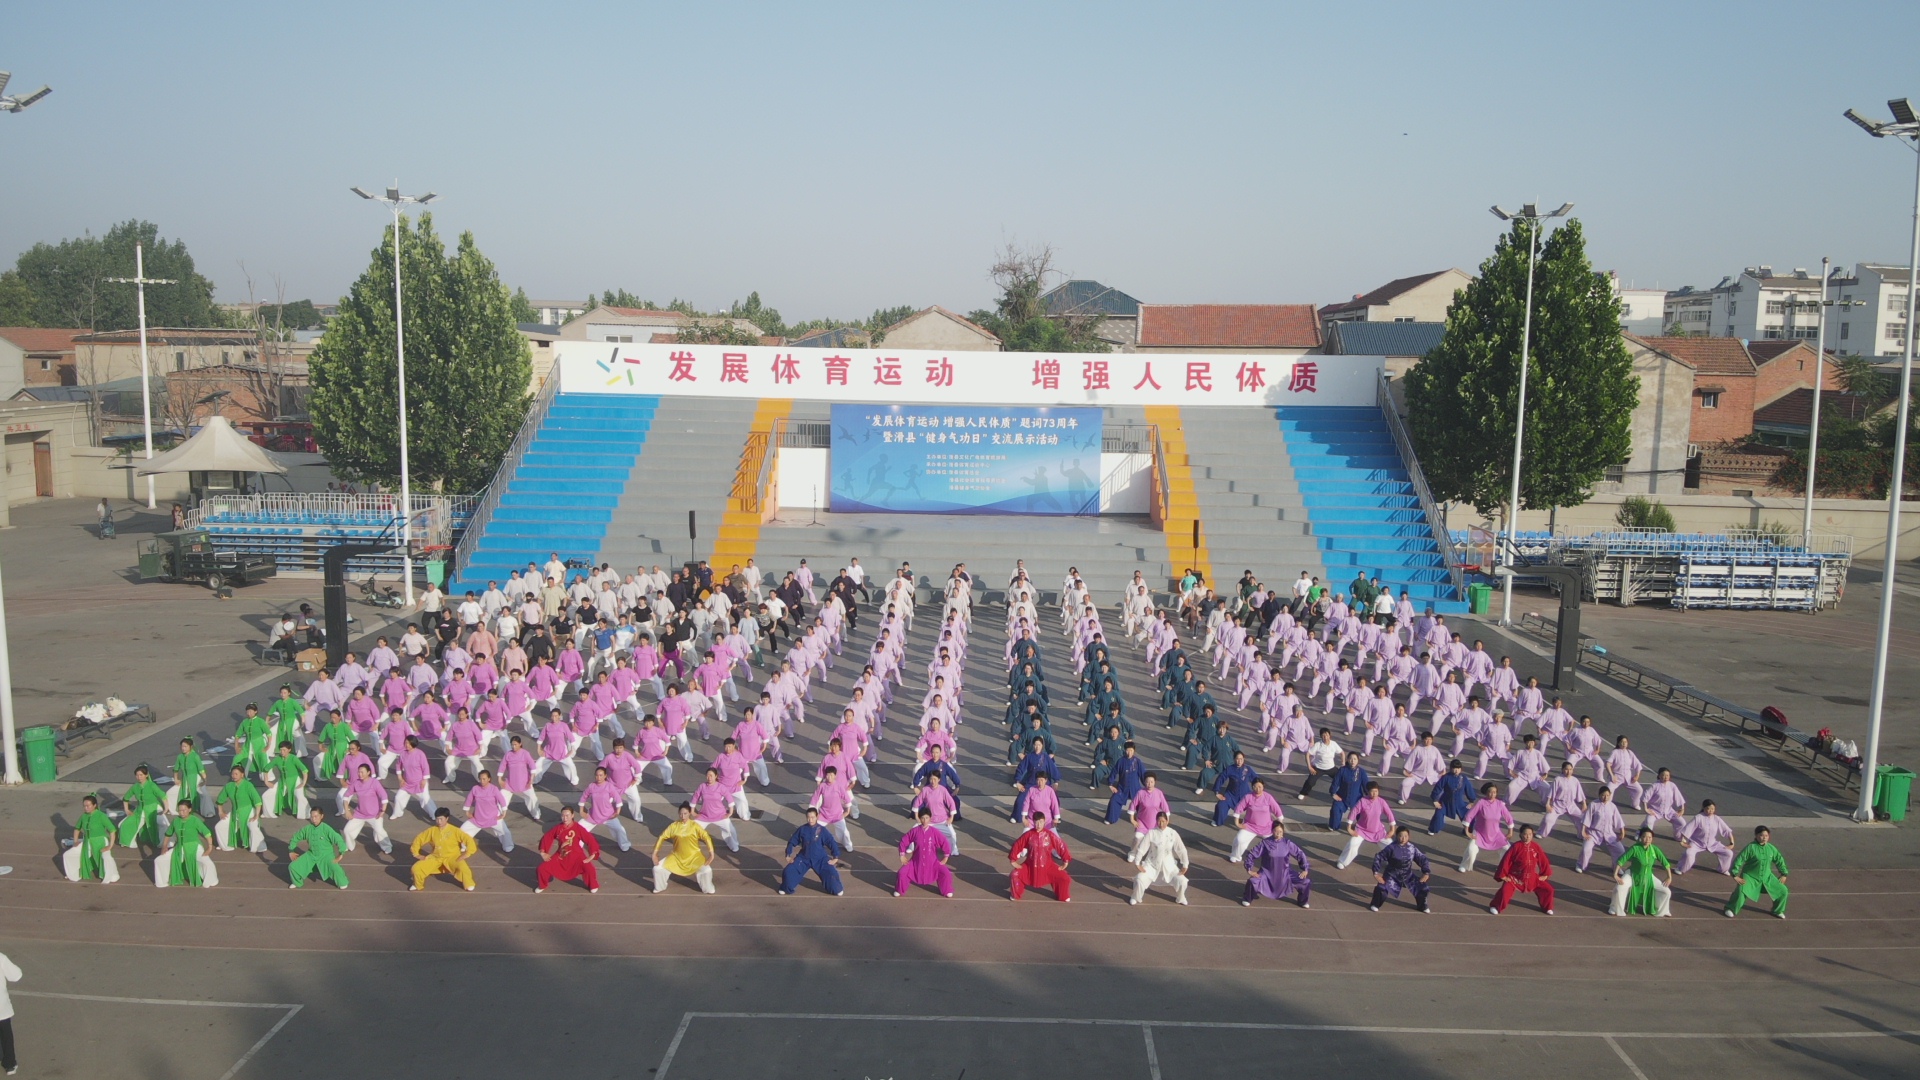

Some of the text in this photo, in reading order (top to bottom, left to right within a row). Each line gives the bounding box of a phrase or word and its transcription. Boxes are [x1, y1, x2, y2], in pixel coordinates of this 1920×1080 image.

[669, 351, 1319, 393] 发展体育运动 增强人民体质
